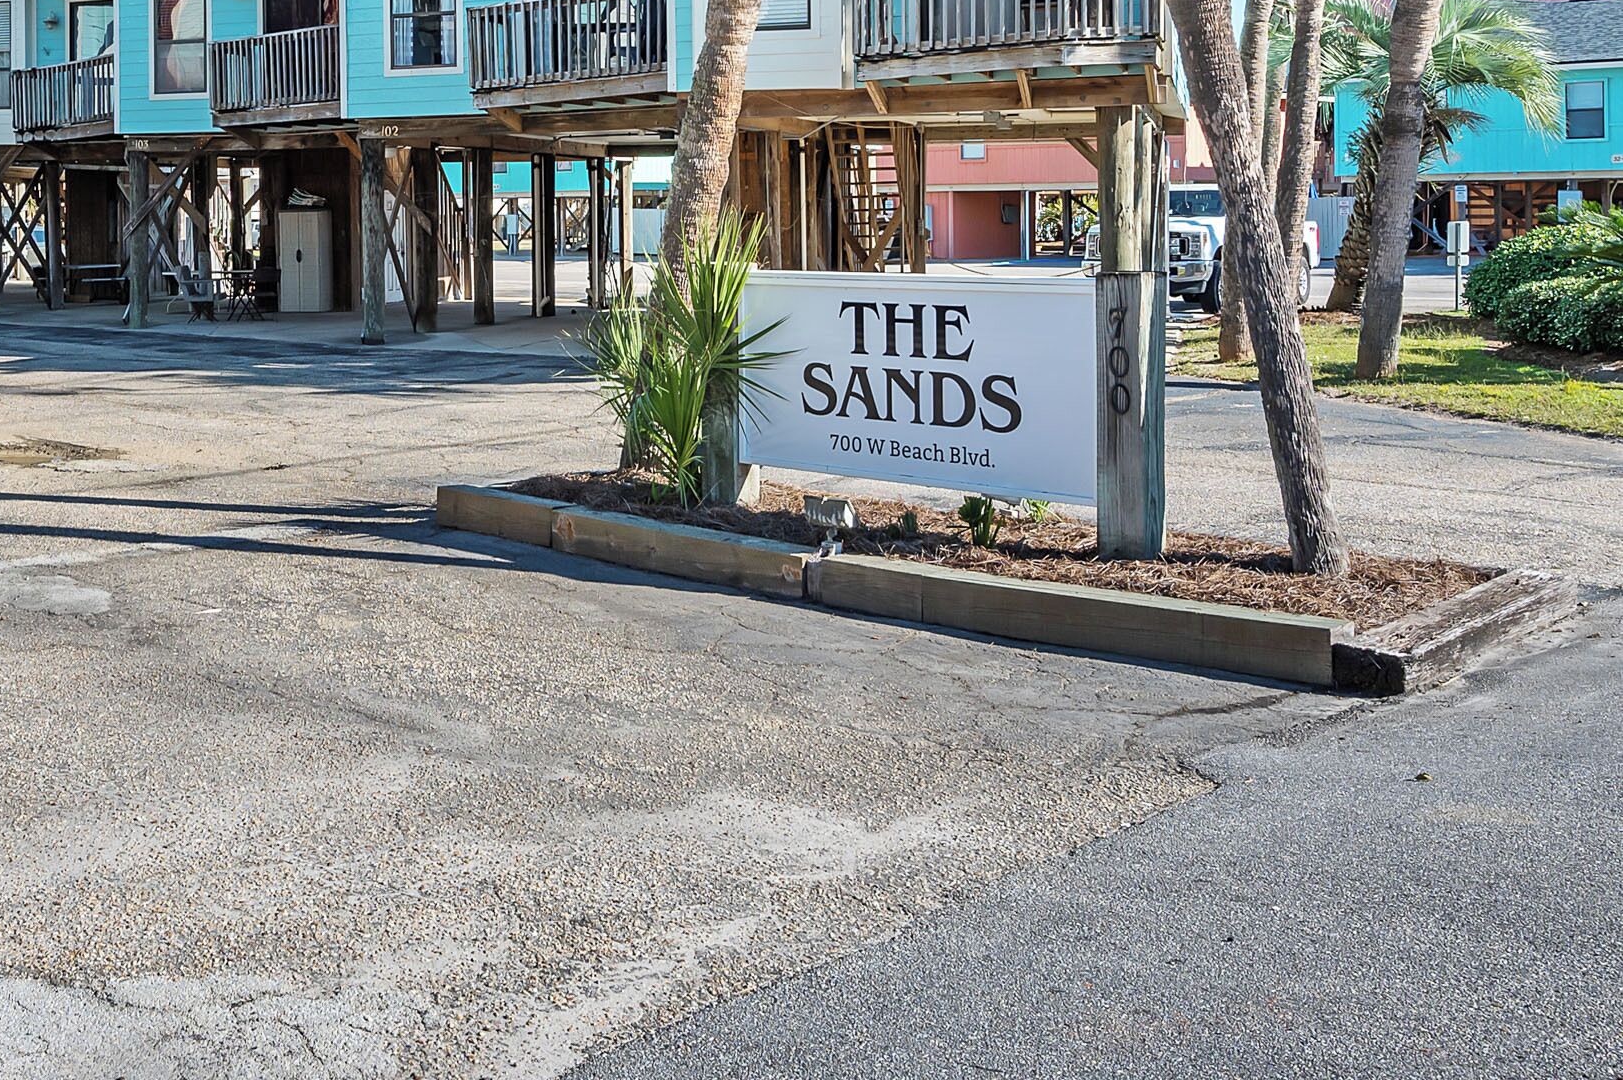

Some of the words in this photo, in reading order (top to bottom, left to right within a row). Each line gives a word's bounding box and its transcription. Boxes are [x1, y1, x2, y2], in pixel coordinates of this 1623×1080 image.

[134, 138, 149, 149] 103
[381, 125, 399, 137] 102
[839, 300, 975, 362] THE
[1108, 306, 1131, 416] 700
[800, 362, 1022, 434] SANDS
[830, 434, 862, 453] 700
[866, 437, 886, 456] W
[889, 440, 944, 463] Beach
[949, 446, 996, 469] Blvd.
